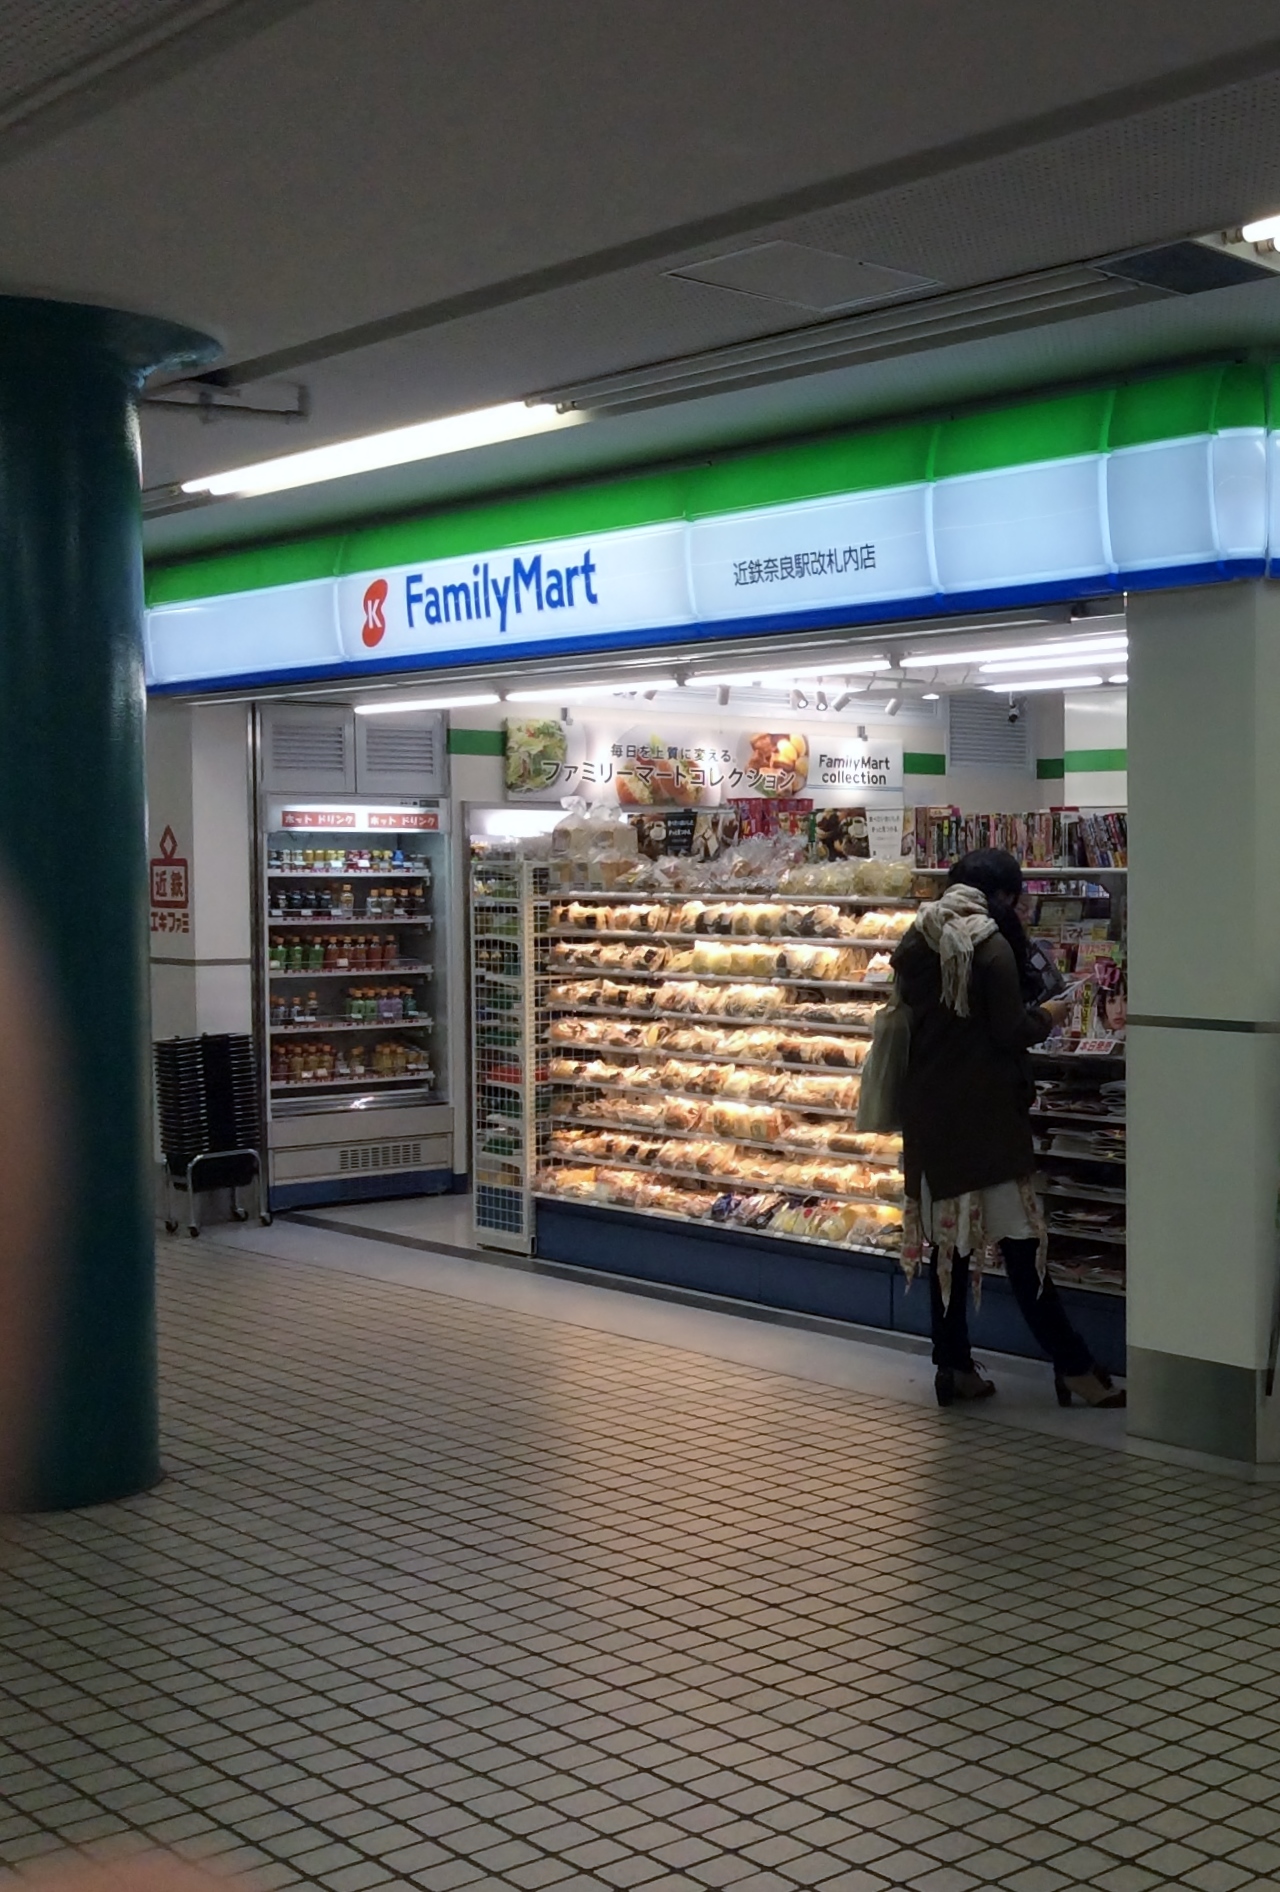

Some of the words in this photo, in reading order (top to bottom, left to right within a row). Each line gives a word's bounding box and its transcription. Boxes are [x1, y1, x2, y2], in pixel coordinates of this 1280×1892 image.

[733, 543, 876, 586] 近鉄奈良駅改札内店
[406, 549, 598, 632] FamilyMart
[818, 753, 891, 772] FamilyMart
[541, 760, 797, 791] ファミリーマートコレクション
[821, 770, 888, 785] collection
[318, 815, 354, 825] ドリンク
[370, 816, 396, 826] ホット
[402, 817, 435, 827] ドリンク
[155, 870, 184, 898] 近鉄
[150, 911, 189, 933] エキファミ
